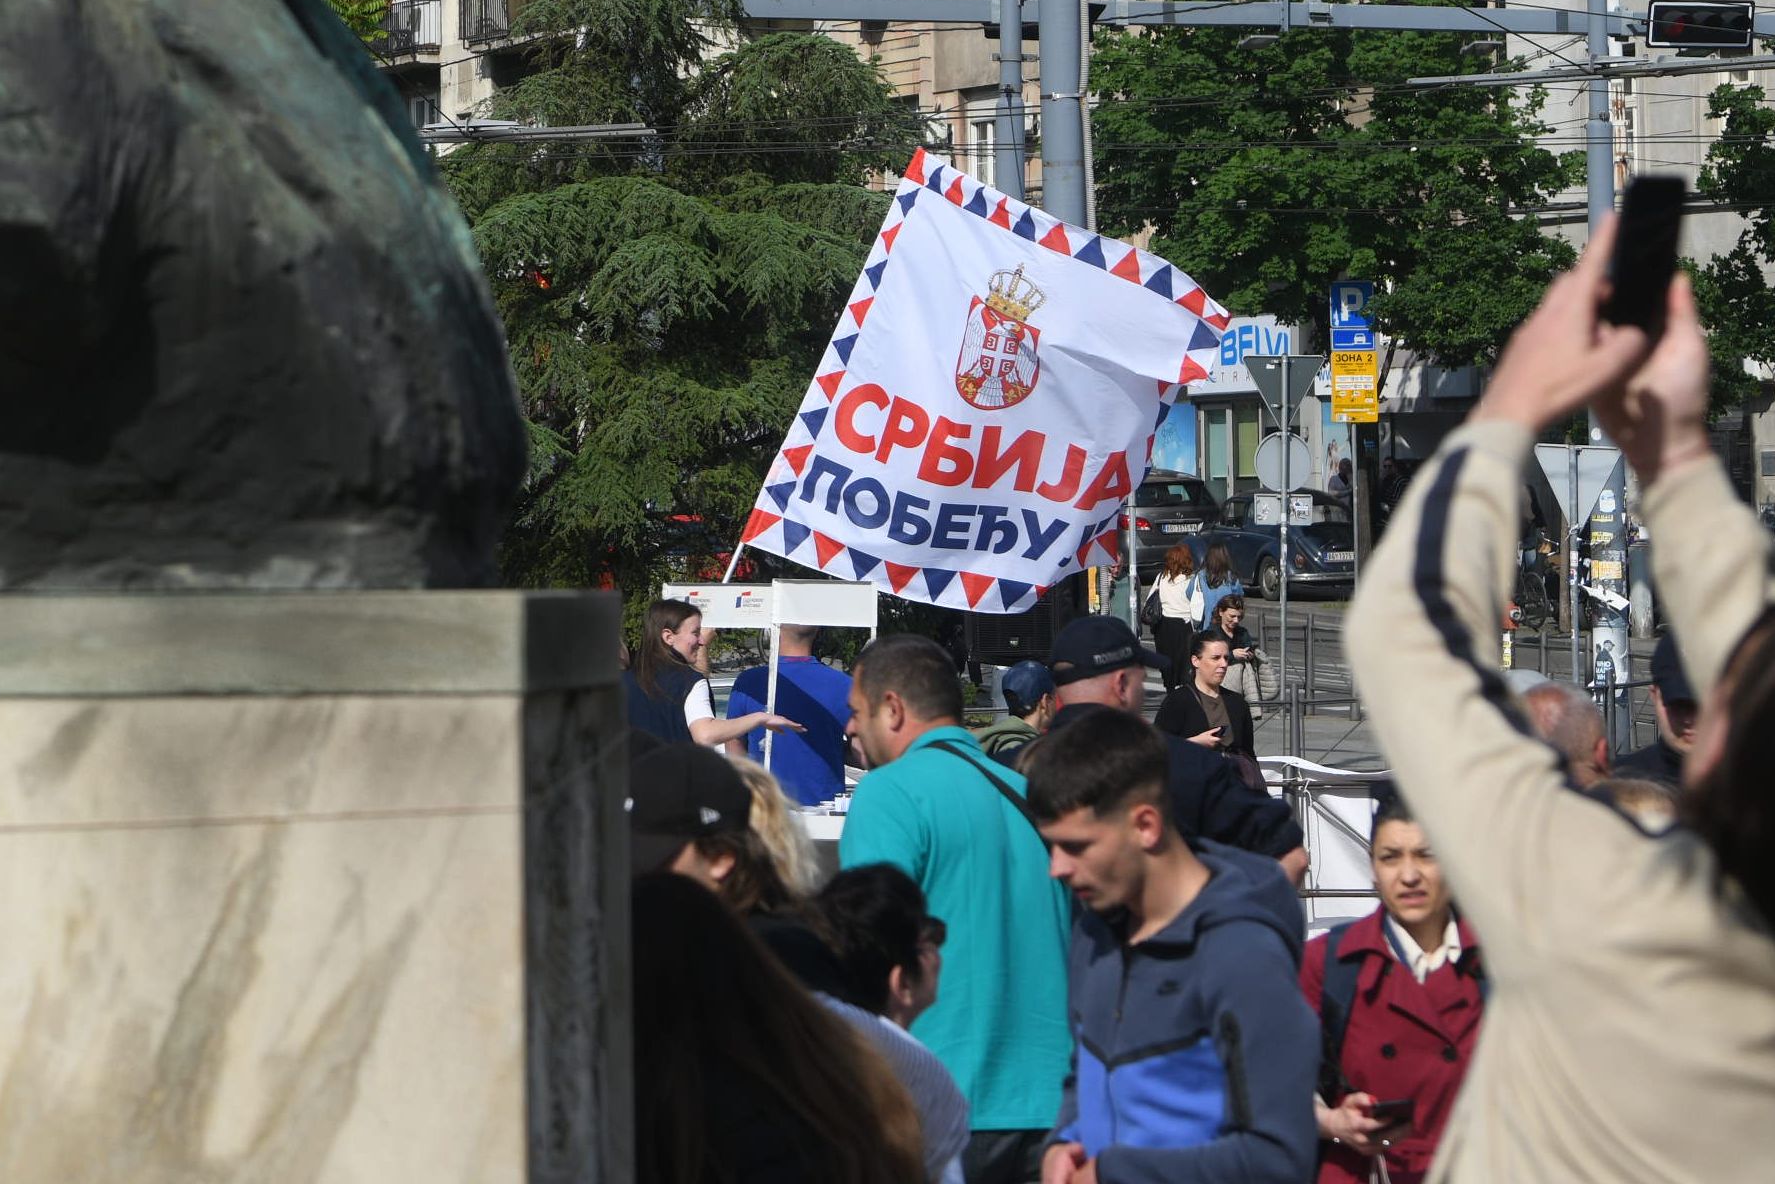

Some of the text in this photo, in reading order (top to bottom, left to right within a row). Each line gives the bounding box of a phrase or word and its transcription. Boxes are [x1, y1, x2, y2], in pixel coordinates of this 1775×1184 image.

[1340, 287, 1364, 321] P
[1335, 354, 1373, 362] ЗОНА 2
[835, 383, 1132, 510] СРБИЈА
